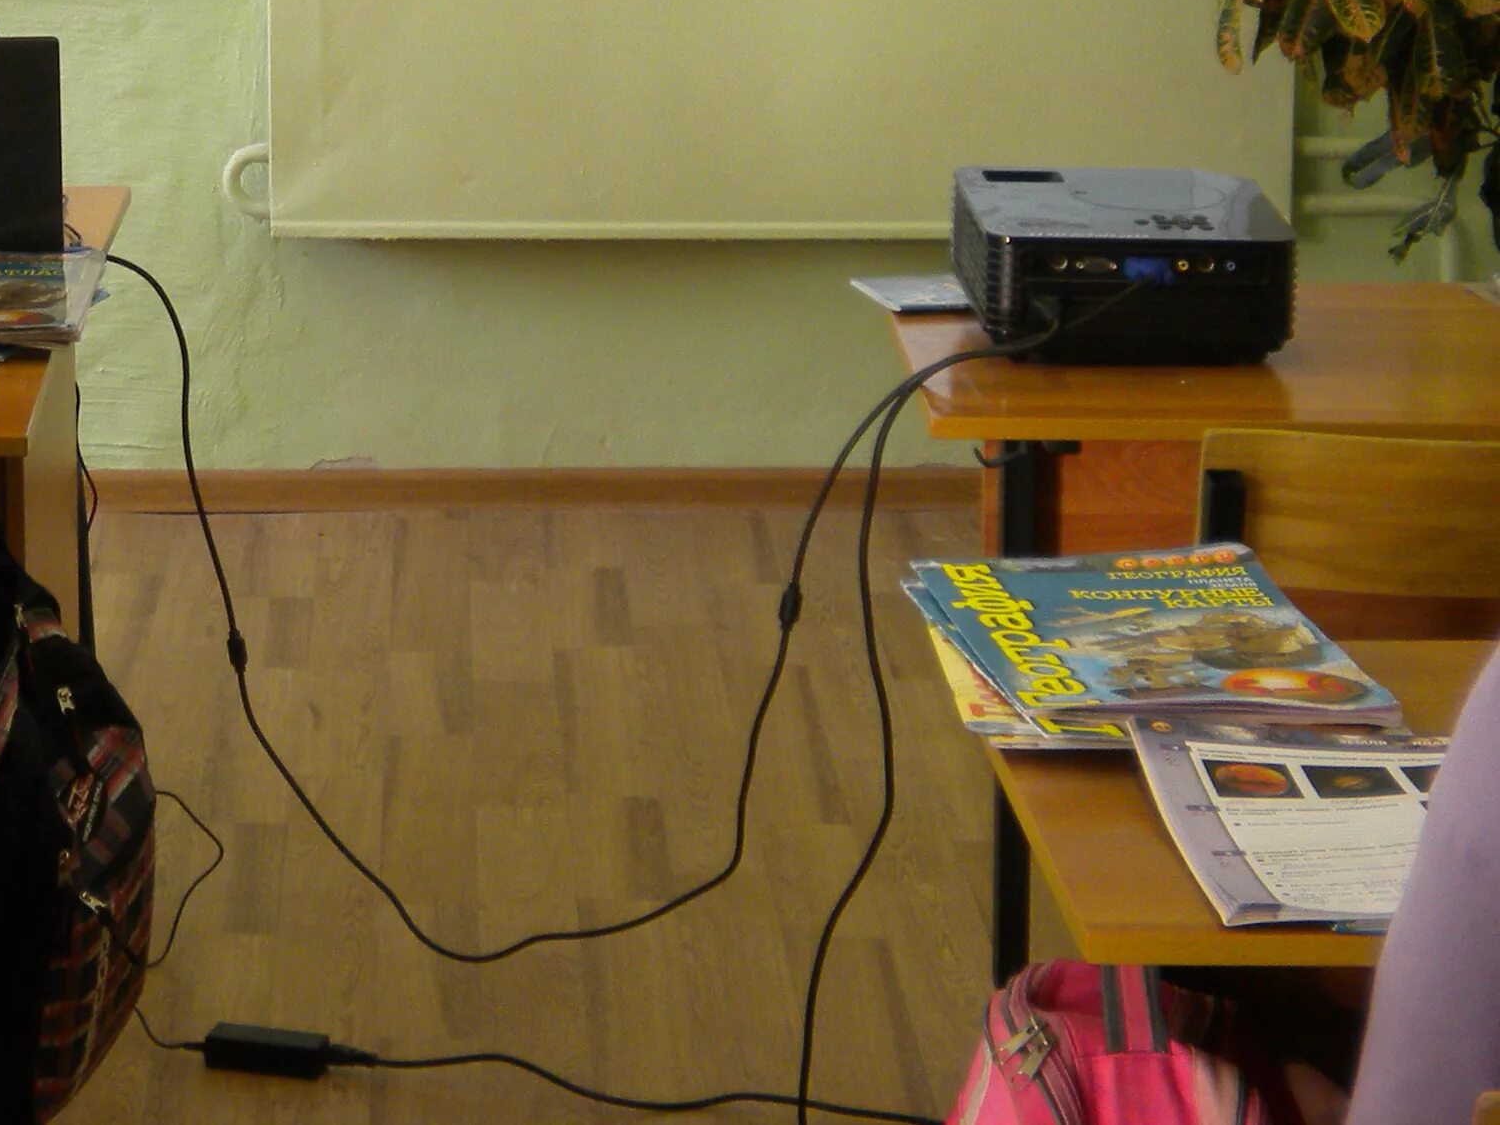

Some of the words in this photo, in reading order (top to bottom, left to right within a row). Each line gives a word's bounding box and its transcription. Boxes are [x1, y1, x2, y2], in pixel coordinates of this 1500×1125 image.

[1105, 565, 1248, 581] ГЕОГРАФИЯ
[1068, 587, 1266, 602] КОНТУРНЫЕ
[1159, 596, 1276, 609] КАРТЫ
